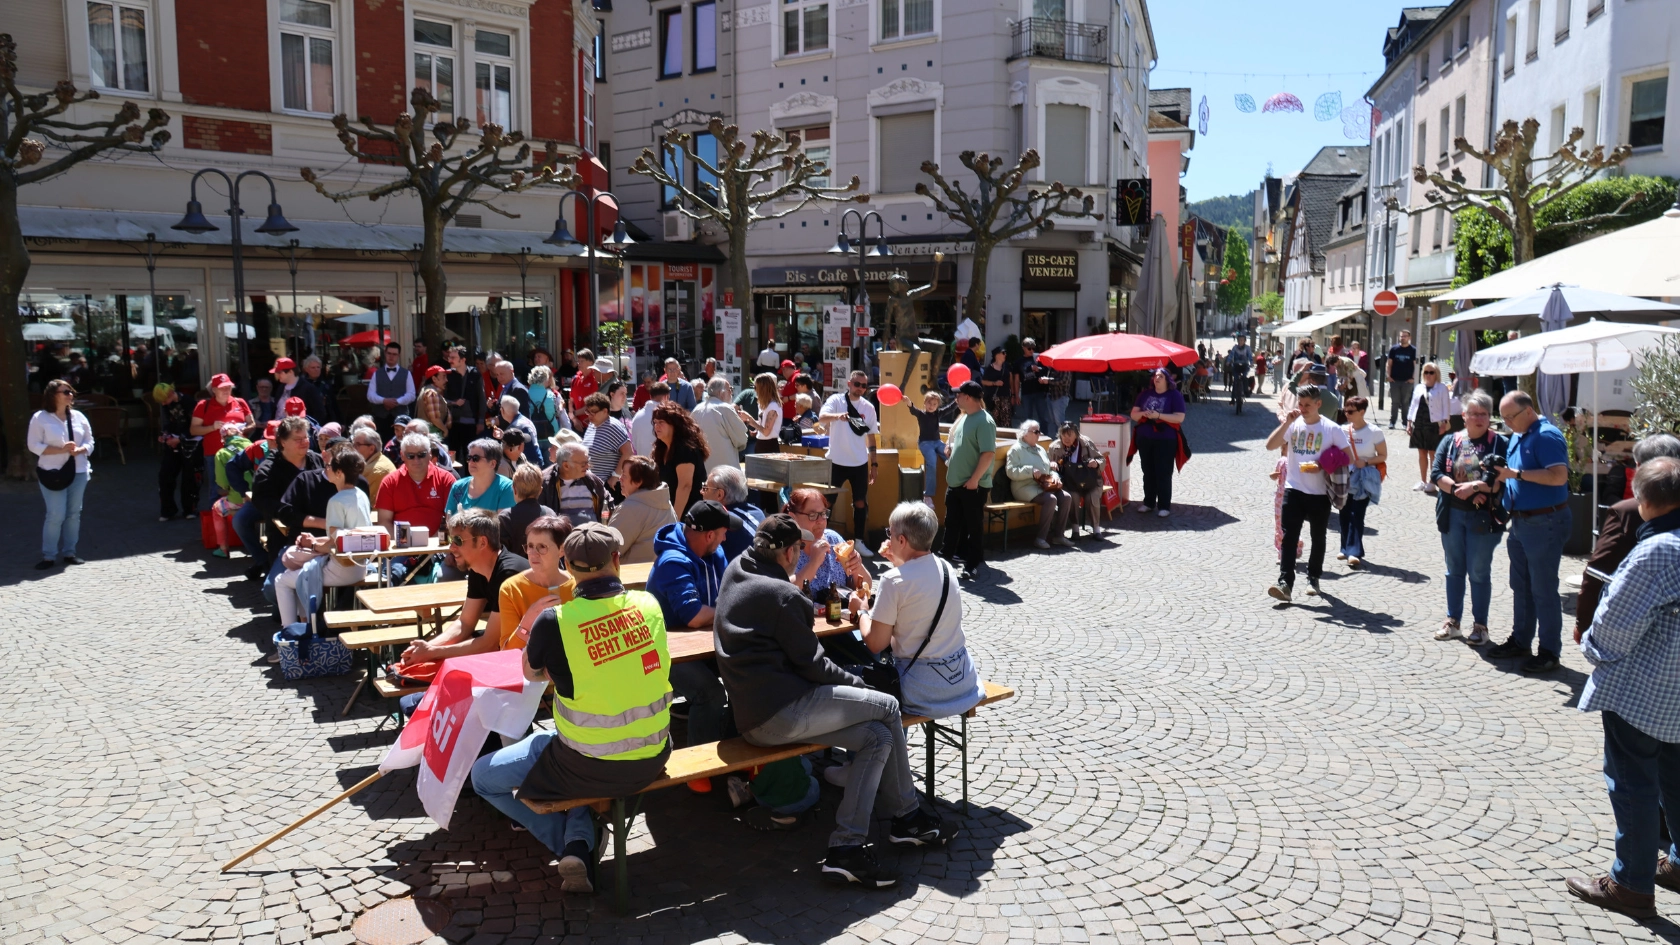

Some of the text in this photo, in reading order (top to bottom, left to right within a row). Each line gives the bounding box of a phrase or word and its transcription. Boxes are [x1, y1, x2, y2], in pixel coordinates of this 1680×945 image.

[1027, 255, 1076, 266] EIS-CAFE
[668, 264, 693, 273] TOURIST
[1029, 266, 1075, 278] VENEZIA
[785, 270, 807, 282] Eis
[818, 269, 848, 282] Cafe
[580, 608, 645, 644] ZUSAMMEN
[587, 625, 652, 661] GEHT MEHR
